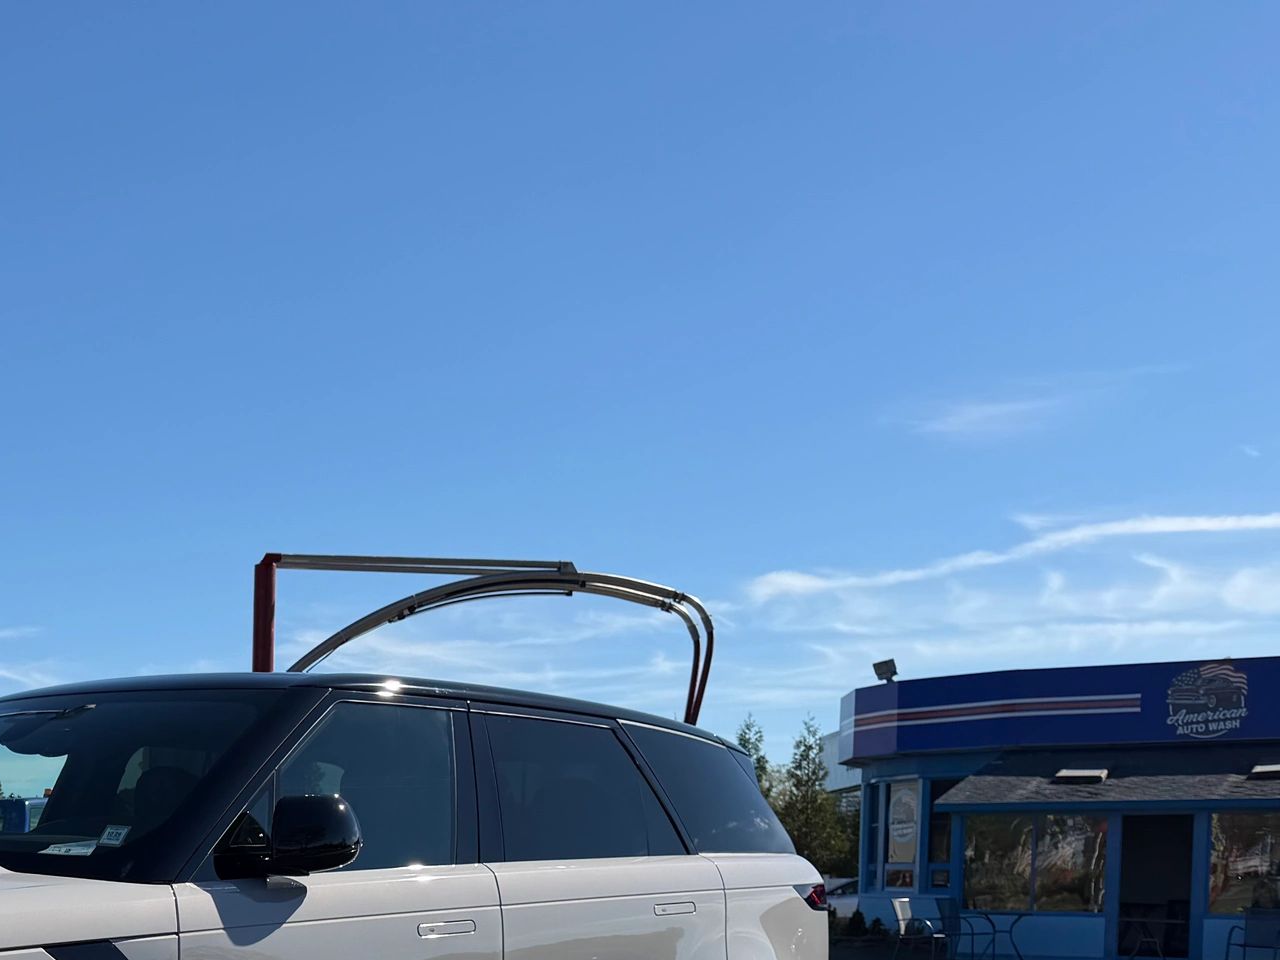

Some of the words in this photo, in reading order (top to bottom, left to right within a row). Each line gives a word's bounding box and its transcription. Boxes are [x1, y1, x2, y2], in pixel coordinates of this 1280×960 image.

[1166, 707, 1248, 725] American
[1176, 723, 1206, 735] AUTO
[1208, 719, 1241, 731] WASH
